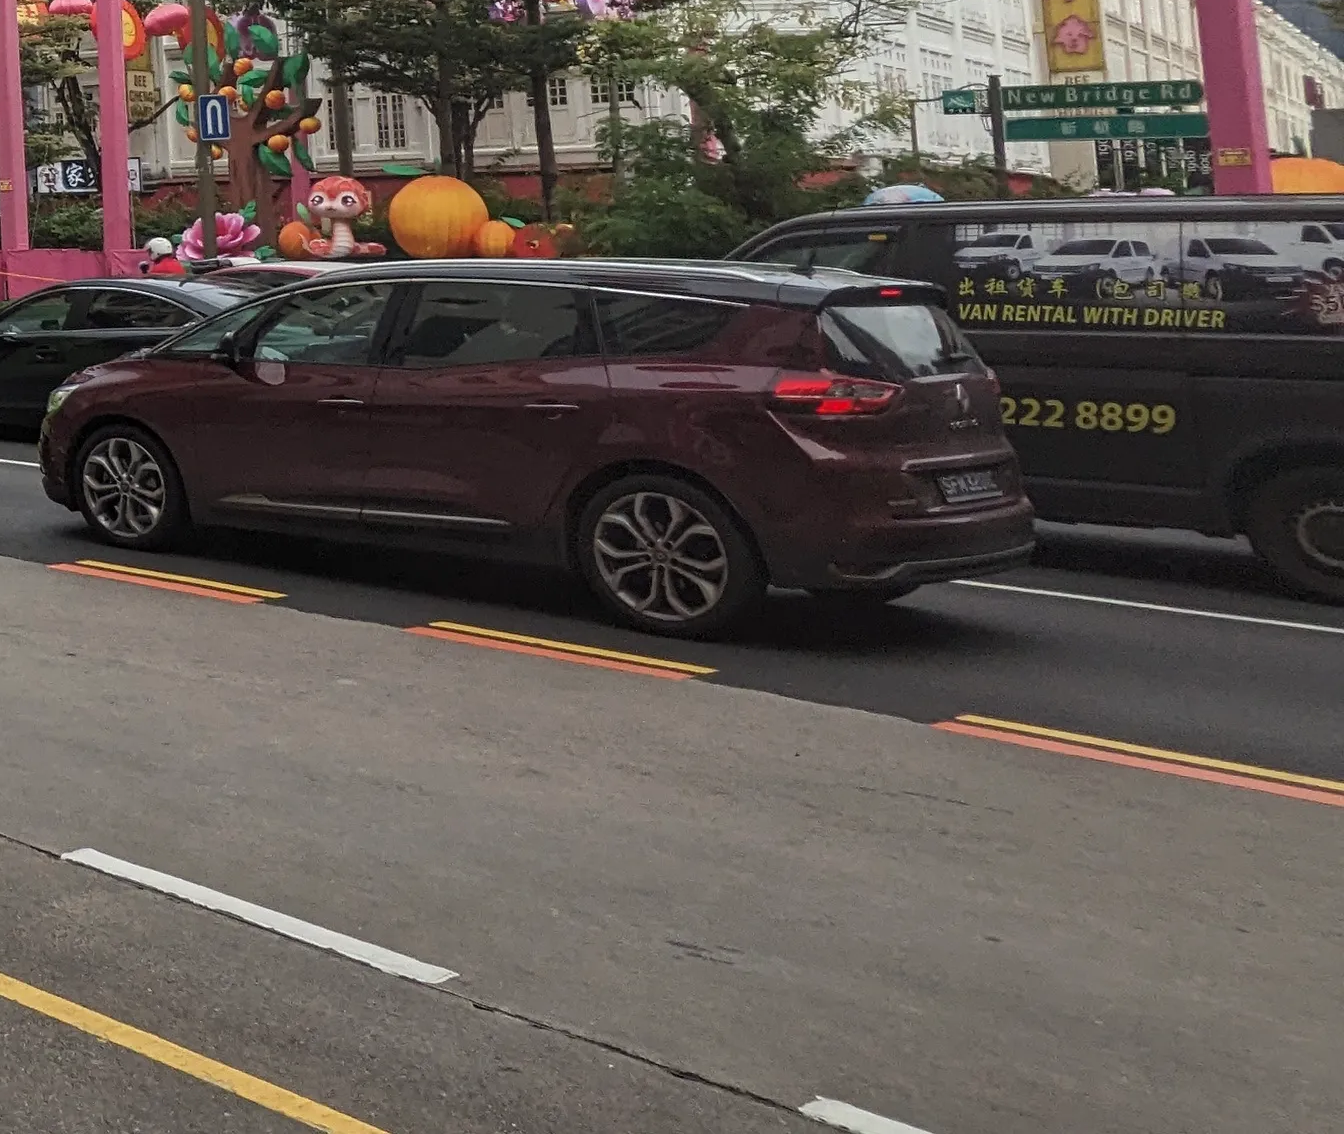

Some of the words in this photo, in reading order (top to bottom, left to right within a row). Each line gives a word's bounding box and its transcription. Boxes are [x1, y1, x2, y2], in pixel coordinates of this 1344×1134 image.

[1007, 88, 1056, 104] New
[1065, 85, 1152, 104] Bridge
[1161, 83, 1192, 100] Rd
[959, 304, 998, 321] VAN
[1002, 304, 1077, 324] RENTAL
[1083, 306, 1137, 326] WITH
[1143, 308, 1226, 328] DRIVER
[1075, 400, 1177, 434] 8899
